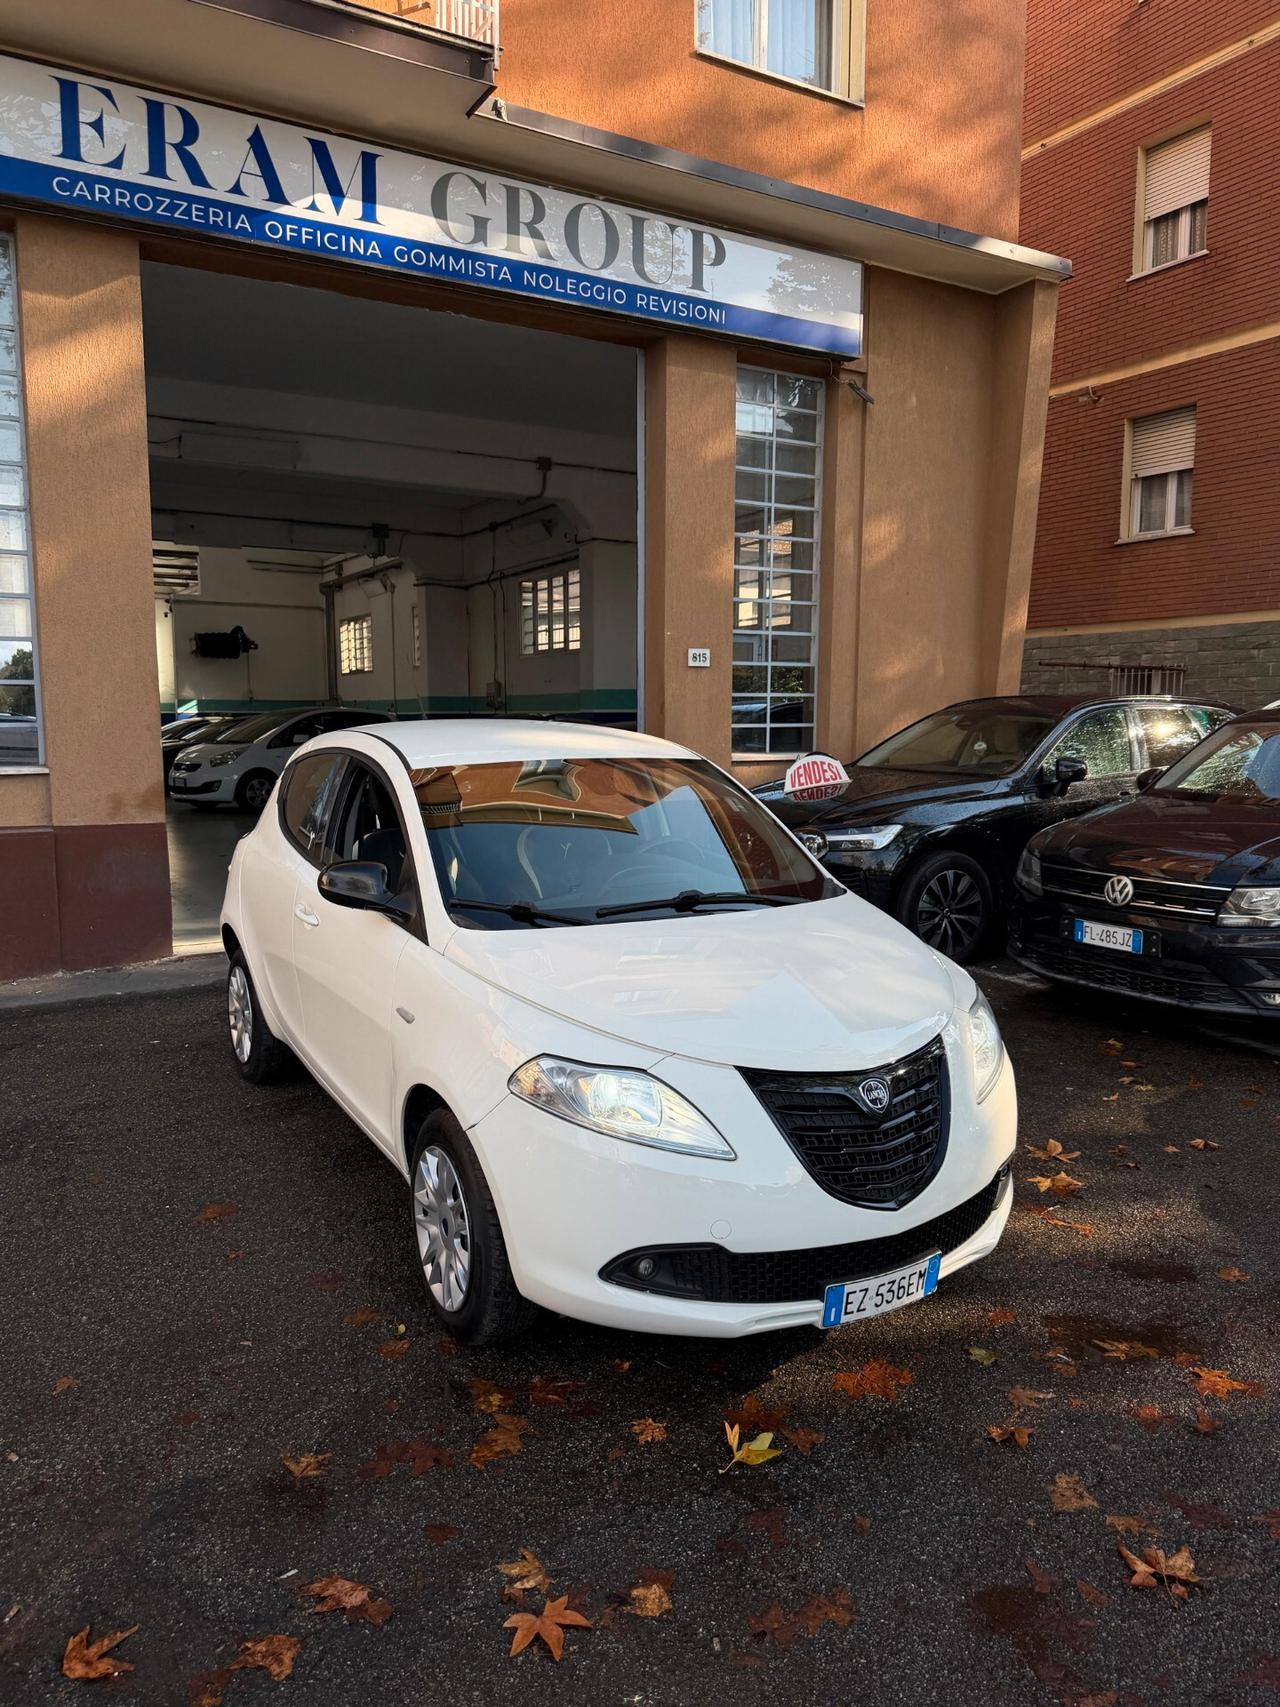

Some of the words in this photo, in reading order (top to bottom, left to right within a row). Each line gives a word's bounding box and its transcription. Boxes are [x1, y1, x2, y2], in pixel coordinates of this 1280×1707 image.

[49, 75, 385, 226] ERAM
[430, 171, 728, 292] GROUP
[52, 176, 253, 233] CARROZZERIA
[265, 220, 382, 258] OFFICINA
[394, 246, 512, 283] GOMMISTA
[523, 270, 627, 305] NOLEGGIO
[637, 293, 727, 325] REVISIONI
[691, 652, 707, 663] 815
[790, 760, 842, 788] VENDESI
